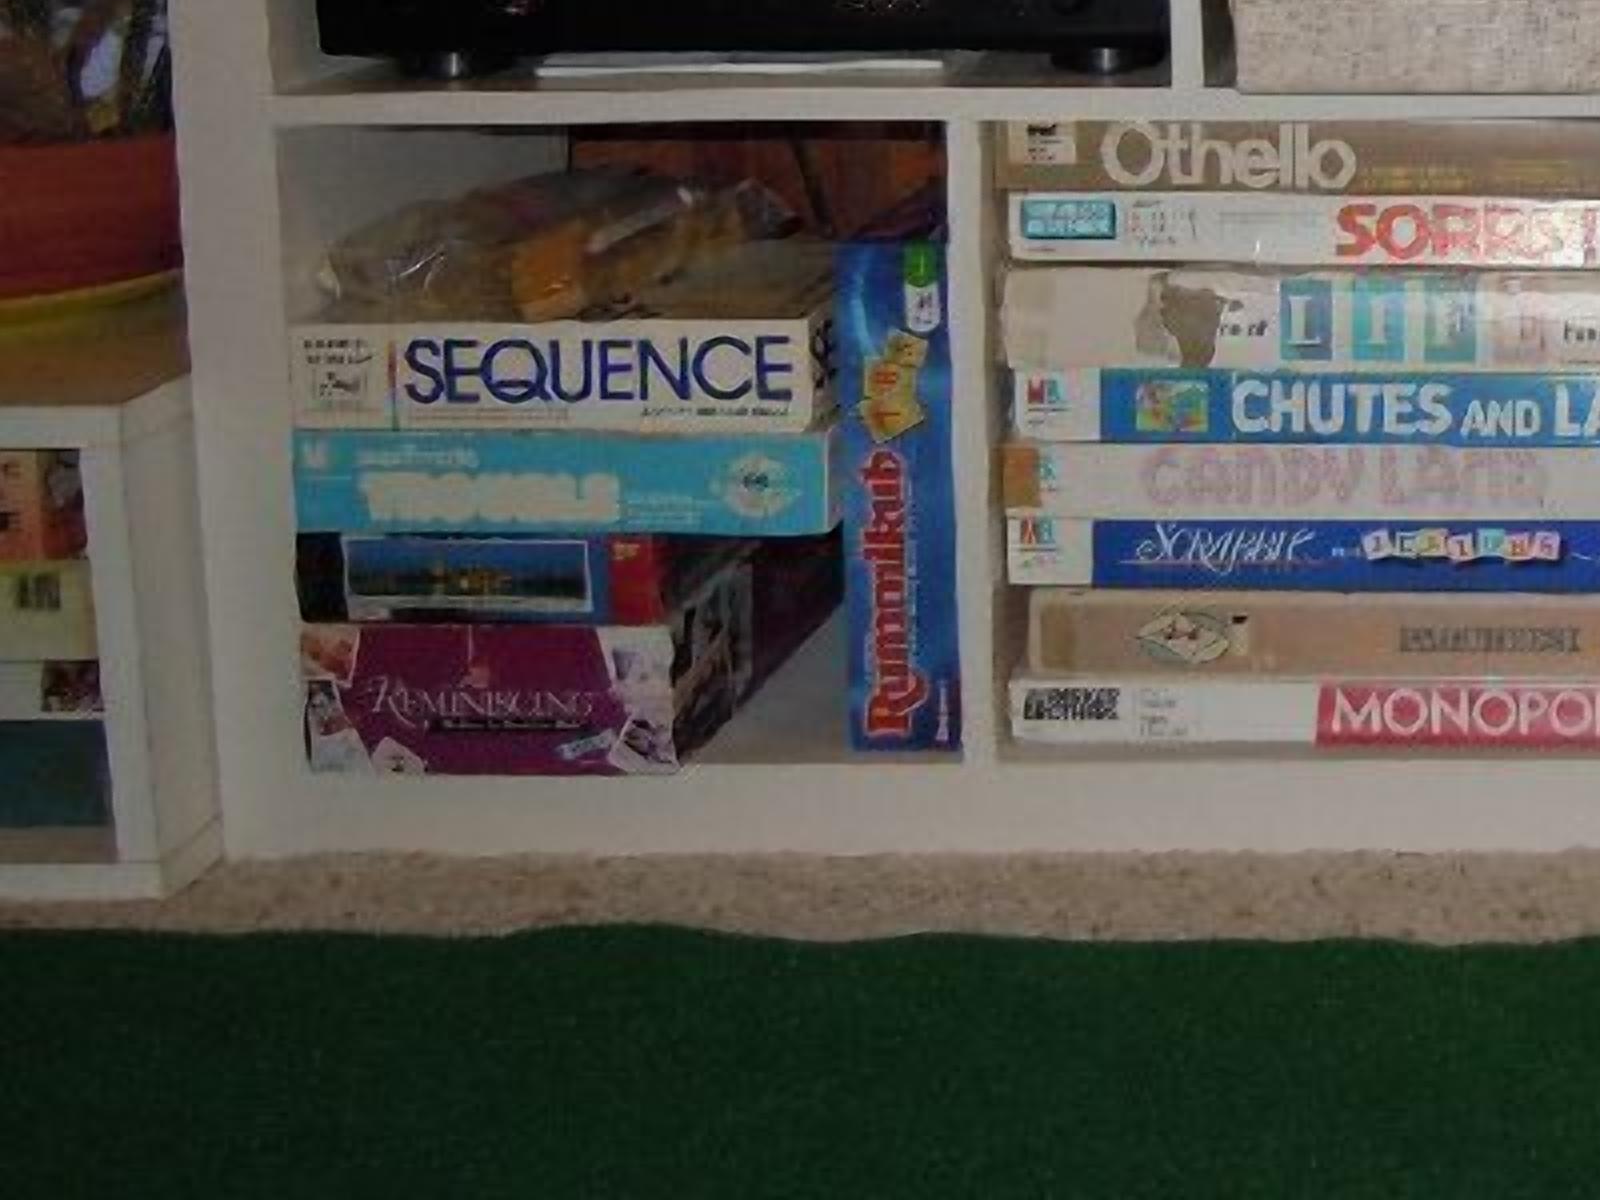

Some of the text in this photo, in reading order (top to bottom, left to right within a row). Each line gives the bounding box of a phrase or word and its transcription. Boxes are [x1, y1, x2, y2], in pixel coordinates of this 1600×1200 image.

[1101, 121, 1358, 189] Othello
[403, 335, 794, 405] SEQUENCE
[1231, 380, 1455, 436] CHUTES
[1460, 399, 1542, 439] AND
[861, 446, 929, 738] Rummikub
